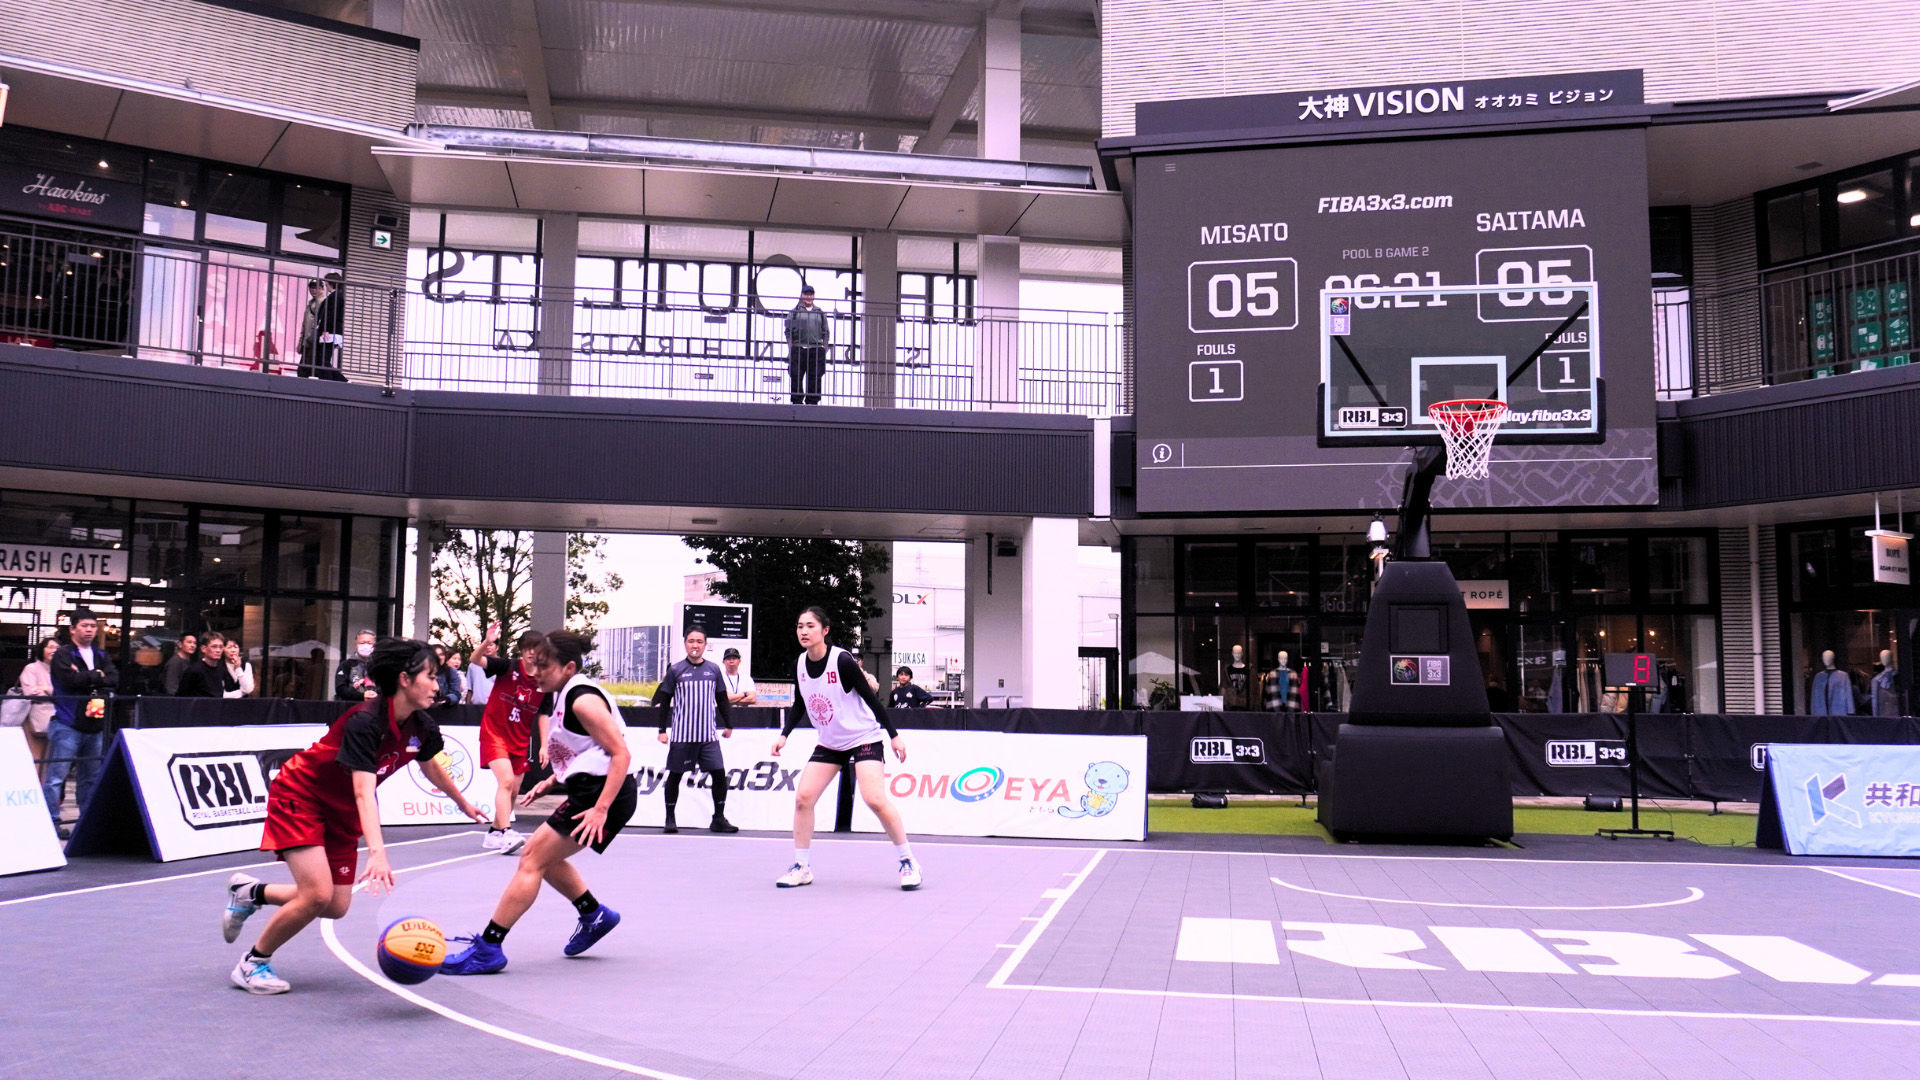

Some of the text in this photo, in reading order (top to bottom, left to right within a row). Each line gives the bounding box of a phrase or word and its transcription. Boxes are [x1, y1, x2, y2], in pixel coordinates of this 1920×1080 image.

[1475, 92, 1539, 110] オオカミ
[1549, 88, 1614, 106] ビジョン
[22, 172, 111, 205] Hawkins
[1317, 194, 1453, 214] FIBA3x3.com
[1476, 208, 1586, 232] SAITAMA
[1201, 223, 1289, 245] MISATO
[1342, 246, 1430, 260] POOL B GAME 2
[1497, 259, 1574, 307] 05
[1208, 272, 1279, 318] 05
[1197, 343, 1236, 356] FOULS
[1209, 367, 1224, 394] 1
[1558, 357, 1575, 384] 1
[1343, 410, 1403, 423] RBL 3x3
[1499, 409, 1592, 425] lay.fiba3x3
[61, 552, 111, 577] GATE
[1470, 589, 1503, 599] ROPÉ
[893, 651, 926, 665] TSUKASA
[826, 671, 838, 684] 19
[1633, 655, 1650, 683] 8
[508, 707, 521, 722] 55
[1194, 741, 1260, 758] RBL 3x3
[1551, 744, 1626, 760] RBL 3x3
[179, 762, 266, 810] RBL
[5, 789, 39, 807] KIKI
